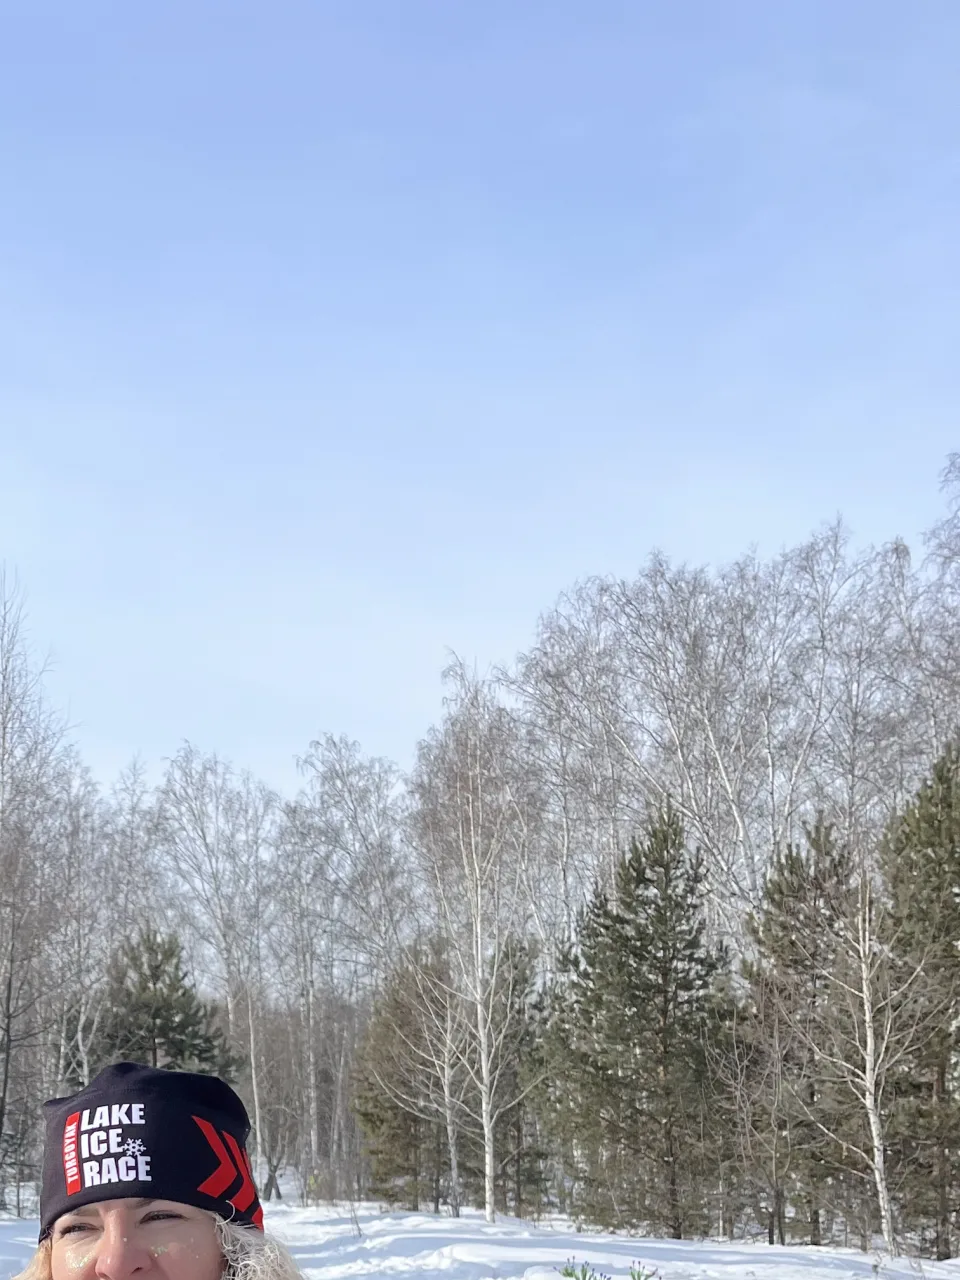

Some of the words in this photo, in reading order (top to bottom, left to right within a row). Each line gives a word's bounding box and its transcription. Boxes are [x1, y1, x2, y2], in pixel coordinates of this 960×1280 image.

[80, 1103, 146, 1132] LAKE
[80, 1128, 124, 1159] ICE
[82, 1155, 152, 1188] RACE
